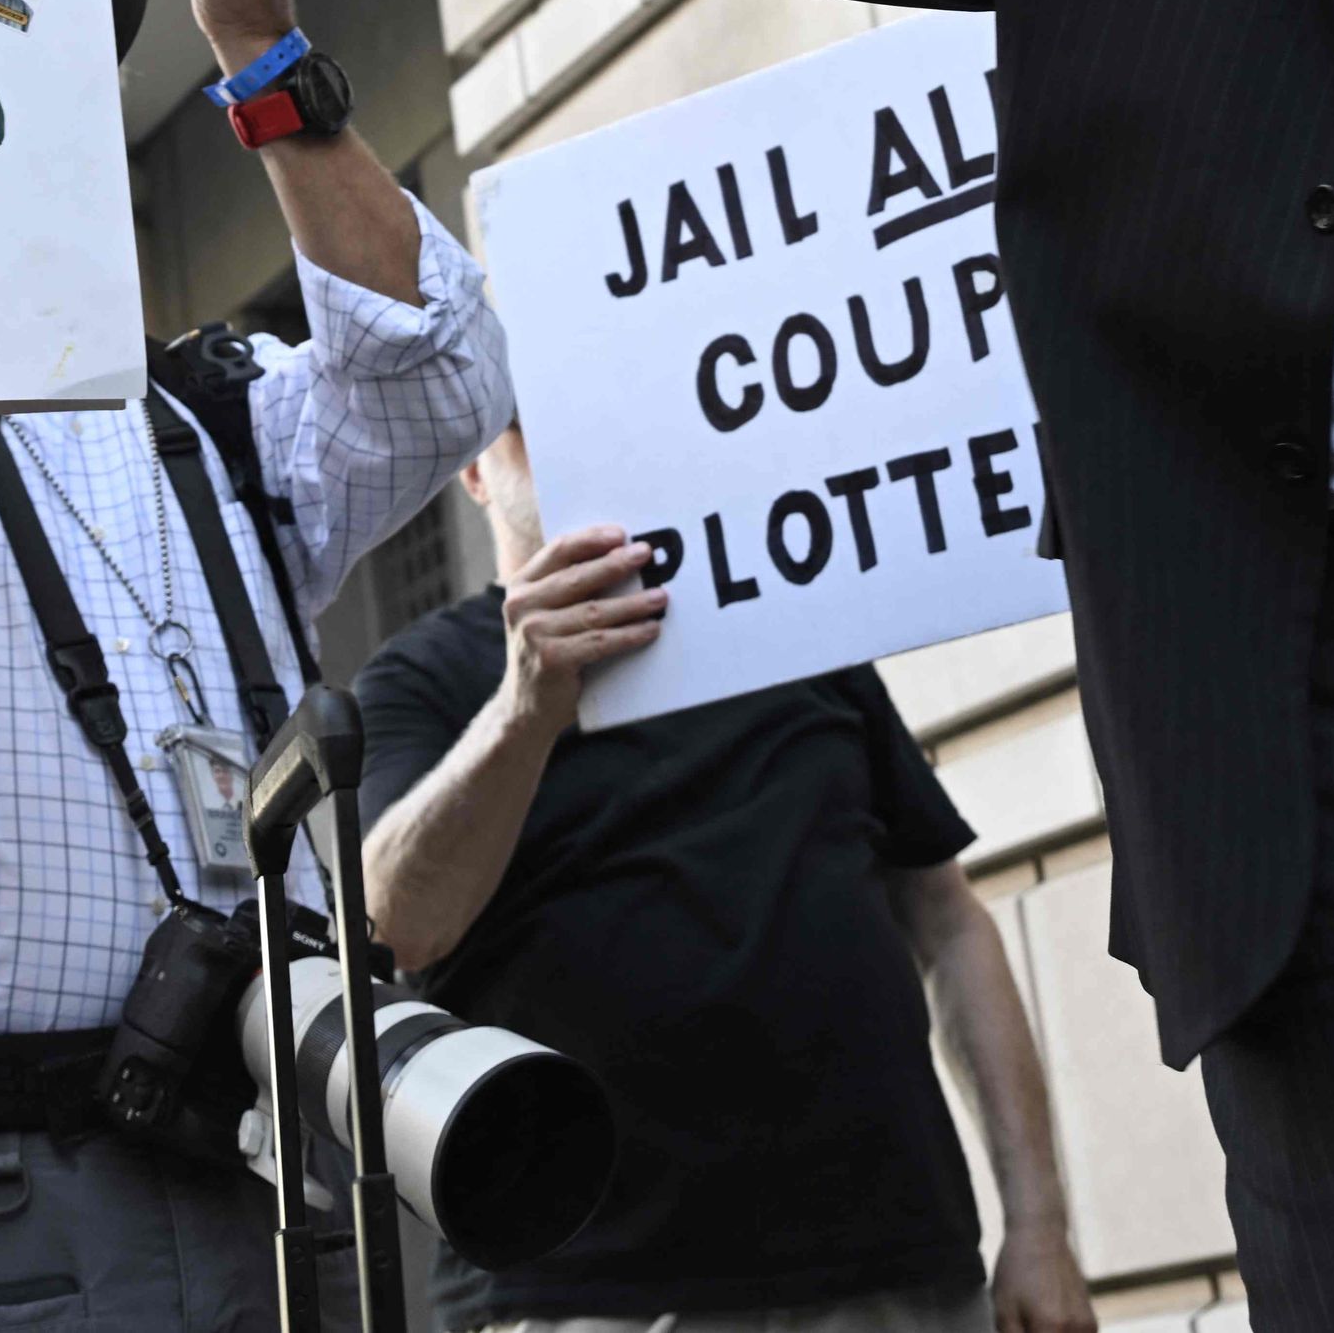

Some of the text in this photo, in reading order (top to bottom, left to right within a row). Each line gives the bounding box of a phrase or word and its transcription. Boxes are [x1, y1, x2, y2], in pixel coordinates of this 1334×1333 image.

[605, 68, 998, 298] JAIL AL
[696, 253, 1006, 432] COUP
[631, 422, 1045, 620] PLOTTE
